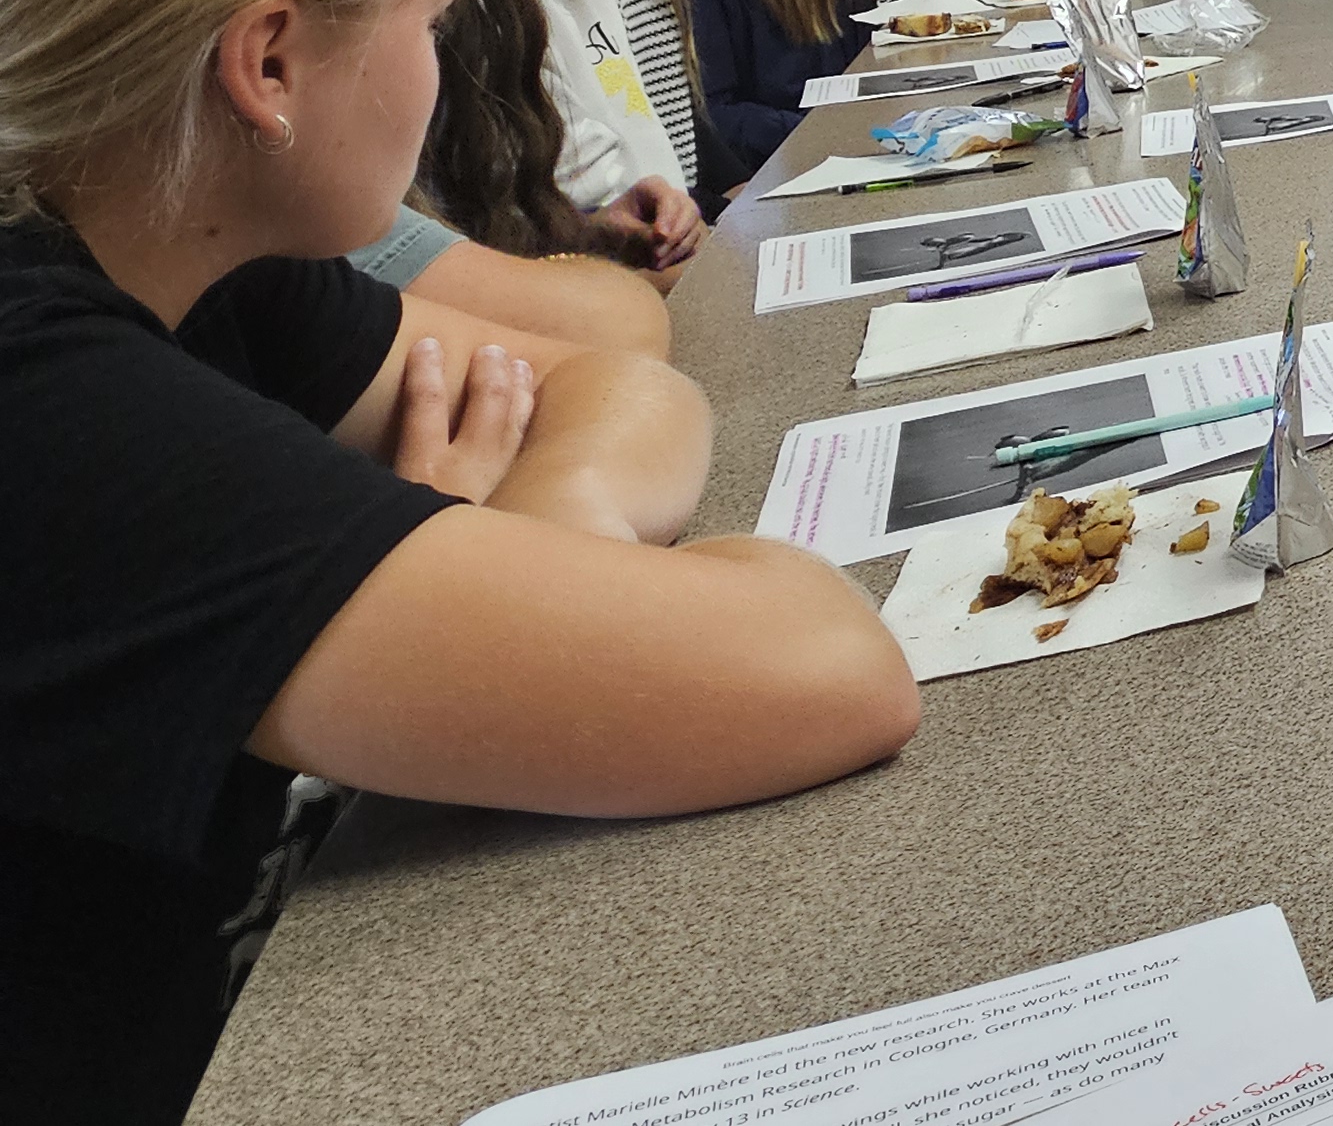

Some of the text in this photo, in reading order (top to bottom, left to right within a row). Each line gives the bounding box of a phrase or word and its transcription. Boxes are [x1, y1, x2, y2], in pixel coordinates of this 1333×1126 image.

[587, 1093, 670, 1124] Marielle
[678, 1072, 750, 1101] Minère
[757, 1062, 788, 1080] led
[795, 1054, 827, 1072] the
[834, 1042, 877, 1061] new
[883, 1017, 975, 1046] research.
[981, 1004, 1017, 1021] She
[1022, 985, 1079, 1010] works
[1084, 975, 1103, 990] at
[1106, 966, 1137, 983] the
[1142, 955, 1181, 973] Max
[632, 973, 1170, 1126] Metabolism Research in Cologne, Germany. Her team
[722, 1056, 754, 1070] Brain
[786, 1041, 810, 1056] that
[811, 1033, 845, 1048] make
[846, 1030, 871, 1042] you
[915, 1010, 940, 1022] also
[941, 1002, 974, 1015] make
[975, 995, 998, 1008] you
[998, 988, 1030, 1000] crave
[1031, 975, 1071, 991] dessert
[904, 1016, 1171, 1109] while working with mice in
[725, 1083, 861, 1126] 13 in Science.
[914, 1030, 1180, 1126] she noticed, they wouldn't
[955, 1102, 1017, 1126] sugar
[1049, 1086, 1073, 1099] as
[1079, 1073, 1105, 1088] do
[1110, 1052, 1165, 1078] many
[1198, 1089, 1291, 1126] iscussion
[1243, 1062, 1325, 1096] Sweets
